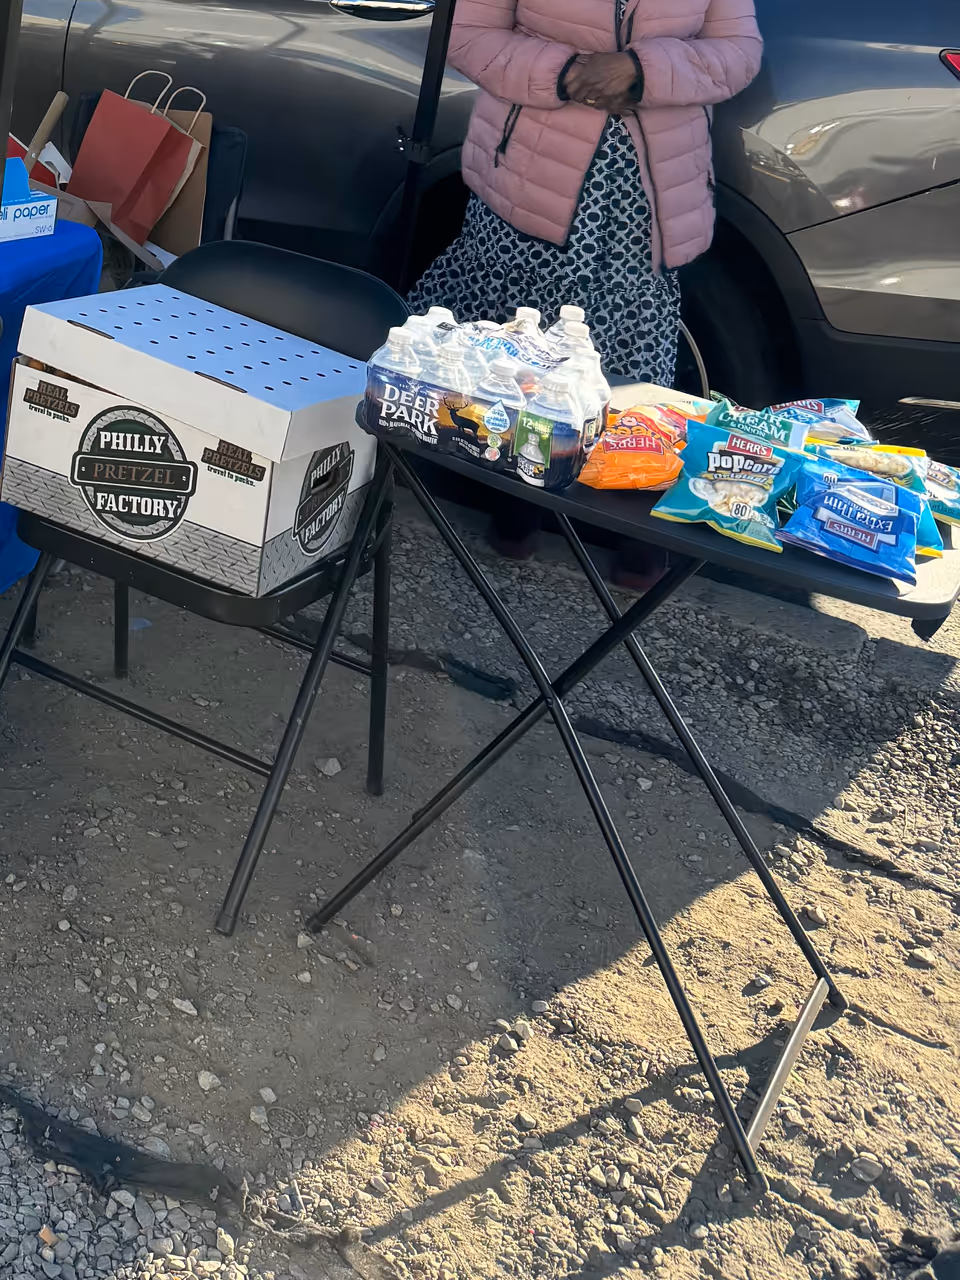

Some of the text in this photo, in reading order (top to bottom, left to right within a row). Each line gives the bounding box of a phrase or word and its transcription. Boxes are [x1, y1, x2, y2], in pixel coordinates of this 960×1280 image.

[13, 204, 50, 222] paper
[25, 389, 77, 415] PRETZELS
[39, 381, 66, 400] REAL
[383, 383, 440, 418] DEER
[376, 397, 439, 436] PARK
[99, 430, 167, 455] PHILLY
[739, 423, 766, 438] ONION
[219, 441, 250, 462] REAL
[731, 437, 768, 456] HERR'S
[92, 462, 176, 487] PRETZEL
[204, 449, 263, 478] PRETZELS
[310, 443, 343, 489] PHILLY
[95, 490, 181, 519] FACTORY
[303, 490, 345, 544] FACTORY
[734, 503, 746, 517] 80
[824, 495, 894, 533] Extra Thin
